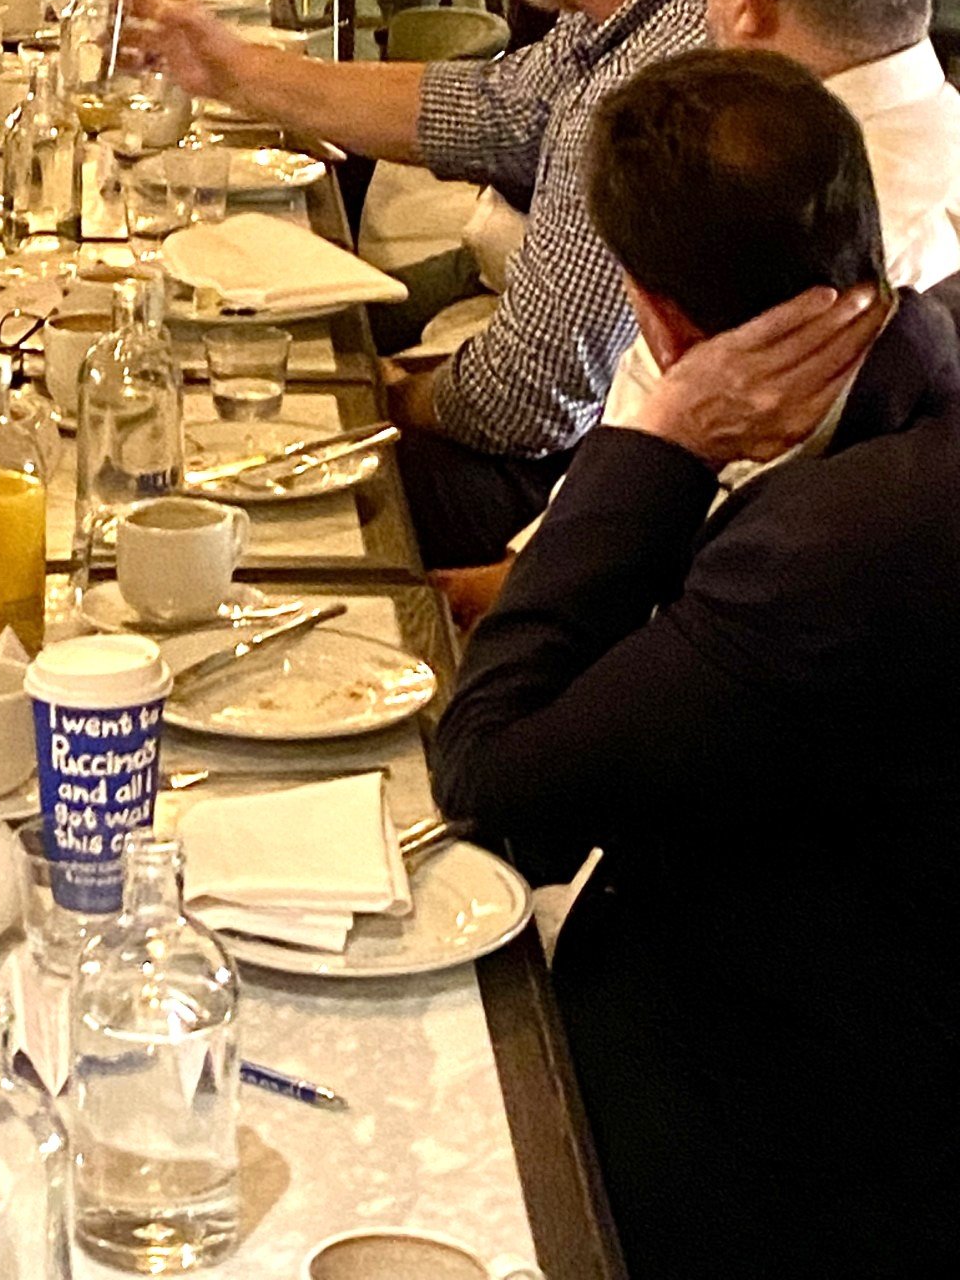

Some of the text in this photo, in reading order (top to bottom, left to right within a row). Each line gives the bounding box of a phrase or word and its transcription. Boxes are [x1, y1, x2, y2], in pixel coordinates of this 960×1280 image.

[49, 703, 159, 738] I went to
[58, 767, 152, 805] and all I
[54, 825, 103, 854] this
